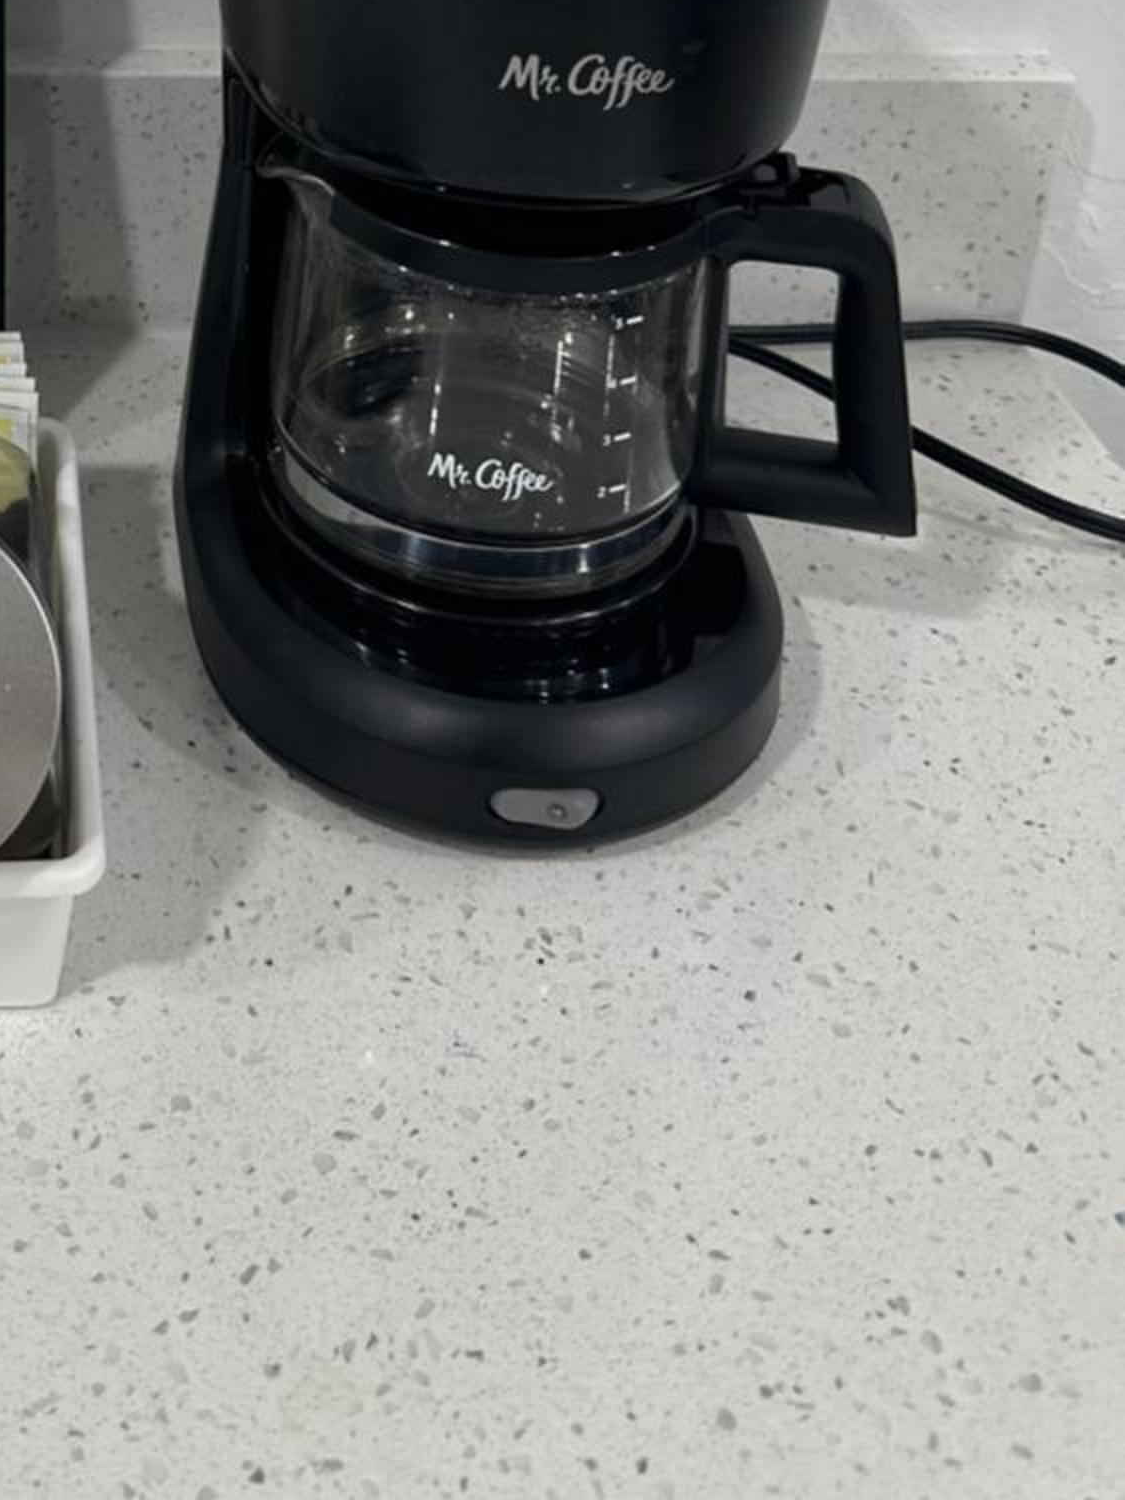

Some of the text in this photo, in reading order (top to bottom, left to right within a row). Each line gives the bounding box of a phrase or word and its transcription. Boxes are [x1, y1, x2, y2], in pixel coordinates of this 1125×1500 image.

[499, 53, 674, 111] Mr. Coffee
[427, 452, 555, 501] Mr. Coffee
